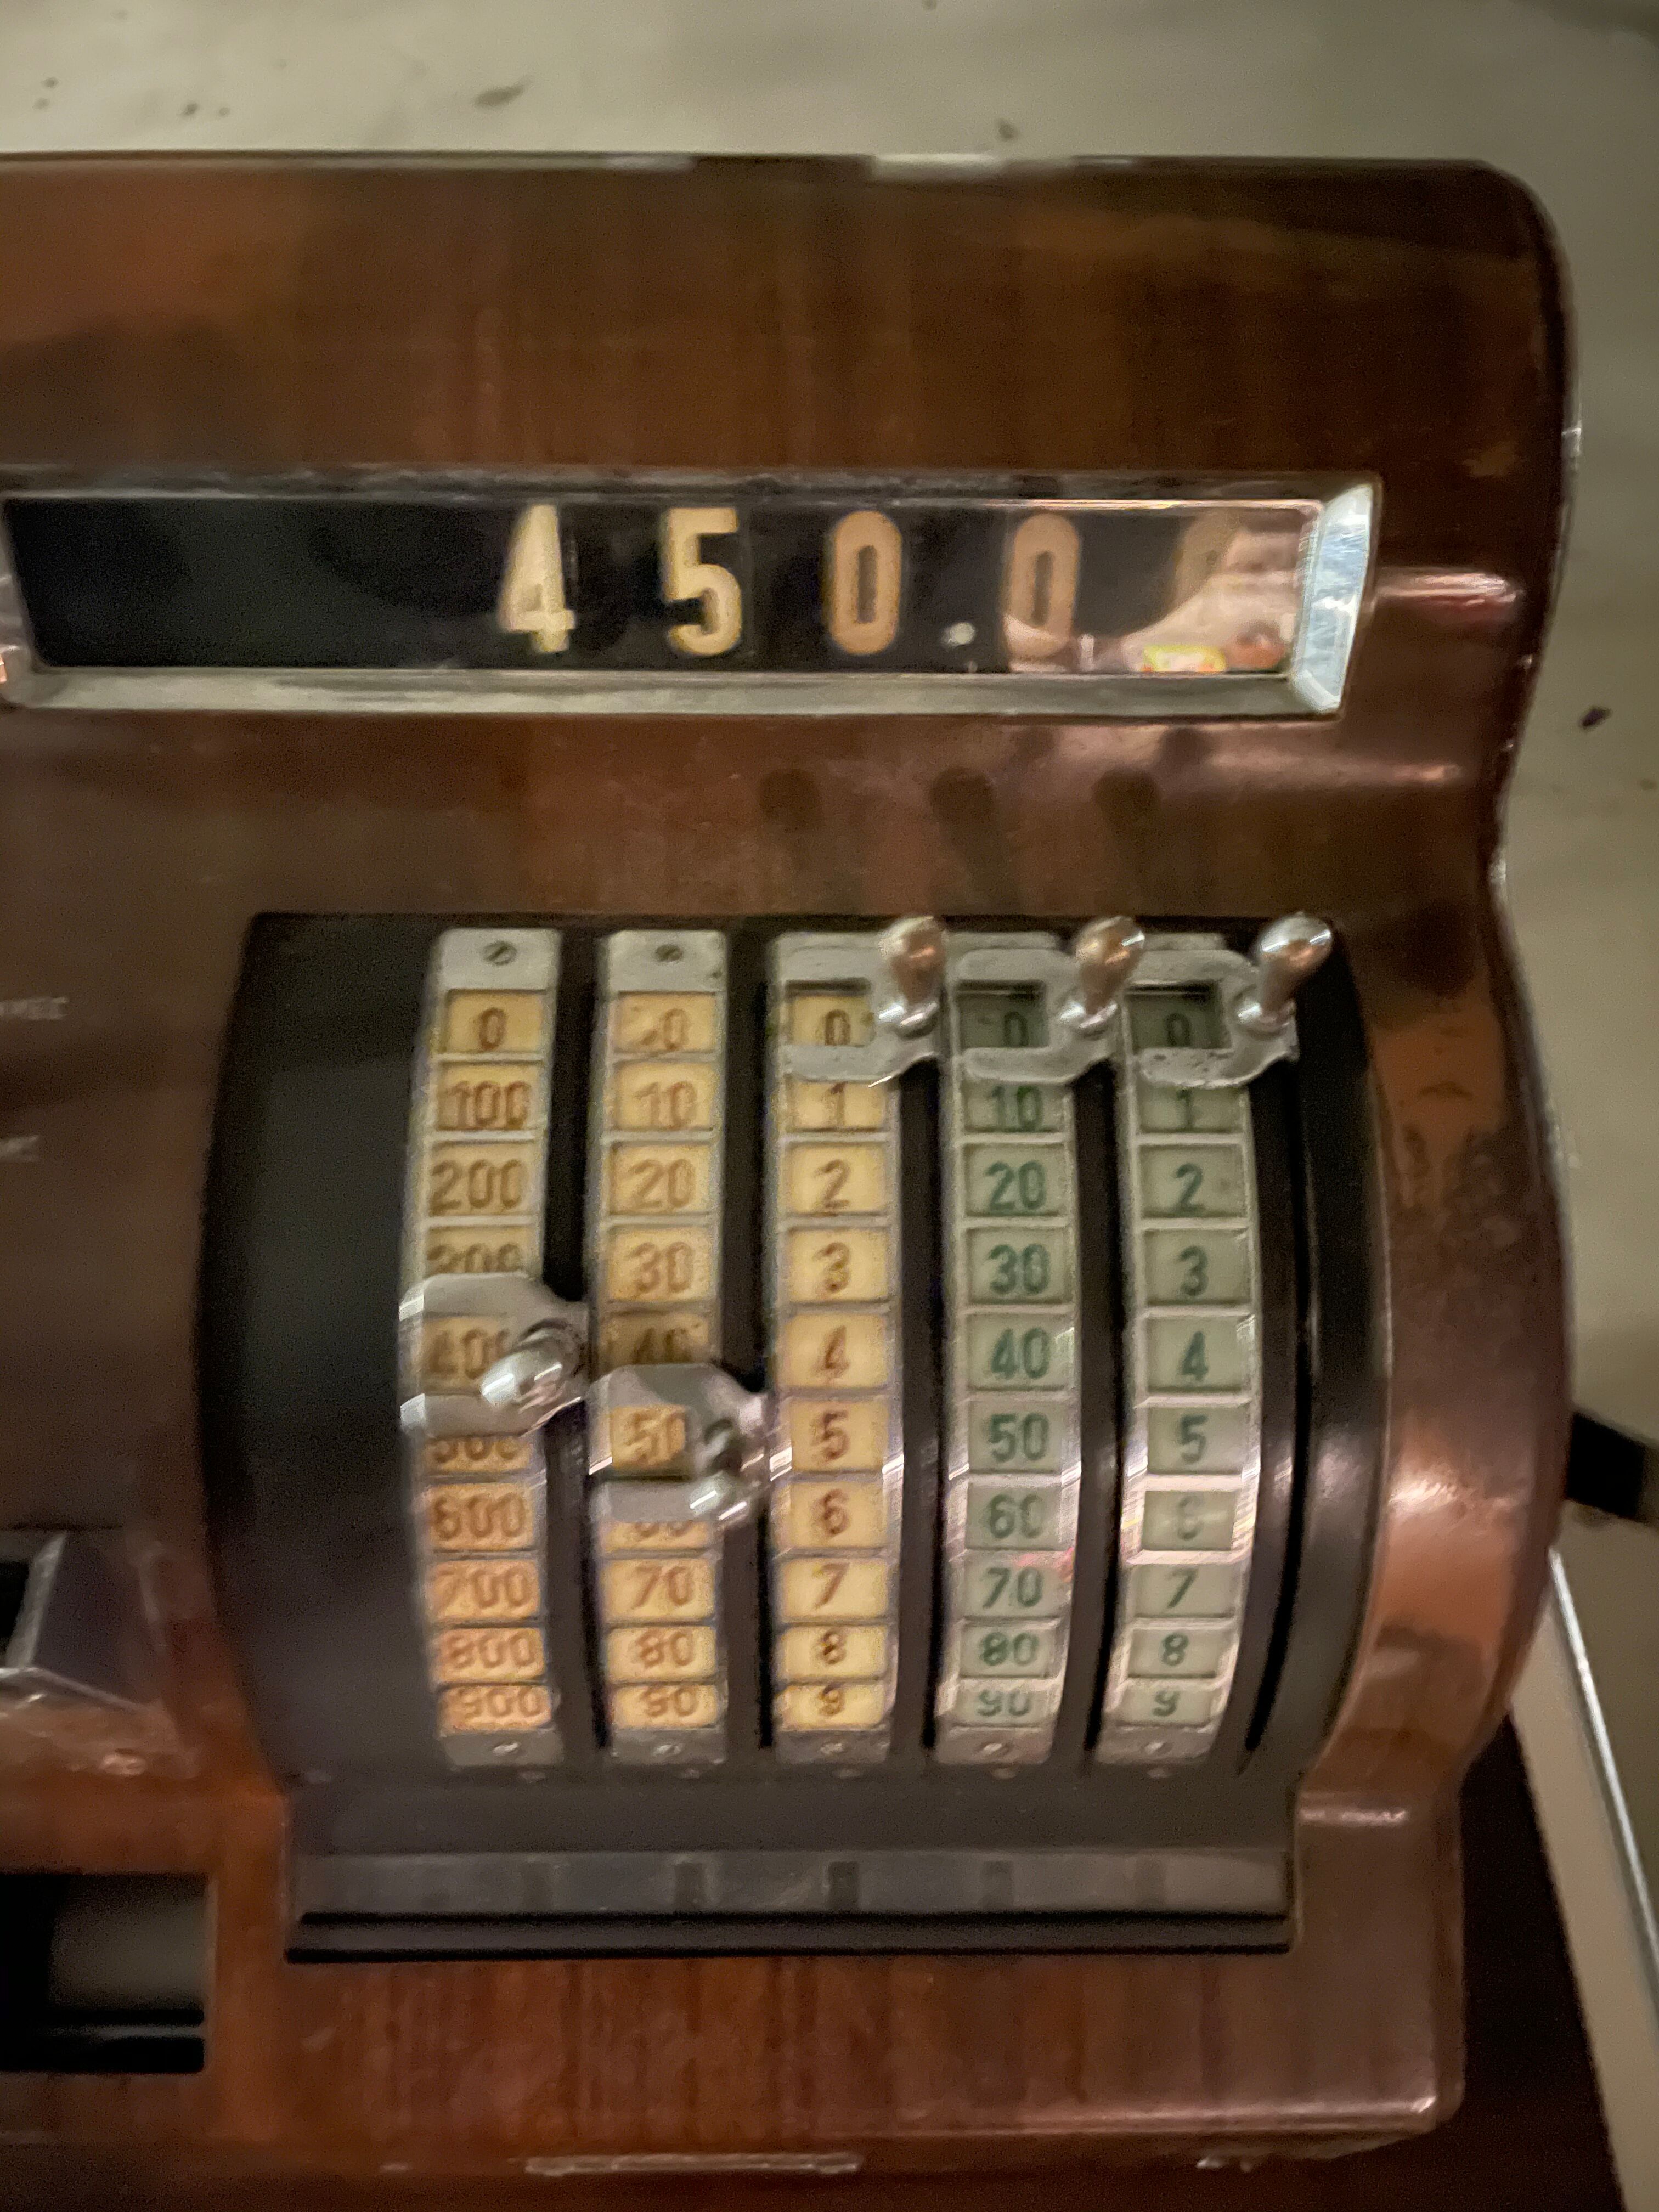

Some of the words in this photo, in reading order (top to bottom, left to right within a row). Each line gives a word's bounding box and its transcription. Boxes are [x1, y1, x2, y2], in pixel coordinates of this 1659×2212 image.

[498, 504, 576, 654] 4
[664, 507, 742, 657] 5
[828, 509, 902, 656] 0
[478, 1008, 508, 1052] 0
[825, 1009, 850, 1045] 0
[1002, 1011, 1029, 1047] 0
[1164, 1013, 1192, 1045] 0
[450, 1081, 533, 1129] 100
[633, 1081, 698, 1129] 10
[826, 1082, 848, 1127] 1
[989, 1085, 1041, 1131] 10
[1177, 1088, 1193, 1129] 1
[430, 1159, 524, 1209] 200
[628, 1159, 695, 1209] 20
[815, 1159, 851, 1210] 2
[986, 1160, 1047, 1211] 20
[1173, 1163, 1204, 1214] 2
[631, 1241, 693, 1293] 30
[813, 1242, 851, 1293] 3
[988, 1243, 1050, 1295] 30
[1178, 1246, 1207, 1296] 3
[815, 1325, 849, 1381] 4
[990, 1328, 1051, 1380] 40
[1177, 1331, 1208, 1381] 4
[812, 1410, 849, 1462] 5
[988, 1413, 1049, 1462] 50
[1176, 1414, 1208, 1464] 5
[431, 1492, 526, 1538] 600
[813, 1489, 849, 1537] 6
[431, 1565, 532, 1608] 700
[634, 1565, 693, 1609] 70
[812, 1563, 850, 1609] 7
[981, 1567, 1043, 1609] 70
[1165, 1568, 1199, 1609] 7
[445, 1631, 535, 1669] 800
[636, 1630, 695, 1669] 80
[819, 1629, 846, 1666] 8
[981, 1631, 1037, 1667] 80
[1160, 1633, 1189, 1667] 8
[819, 1685, 845, 1716] 9
[1153, 1690, 1180, 1717] 9
